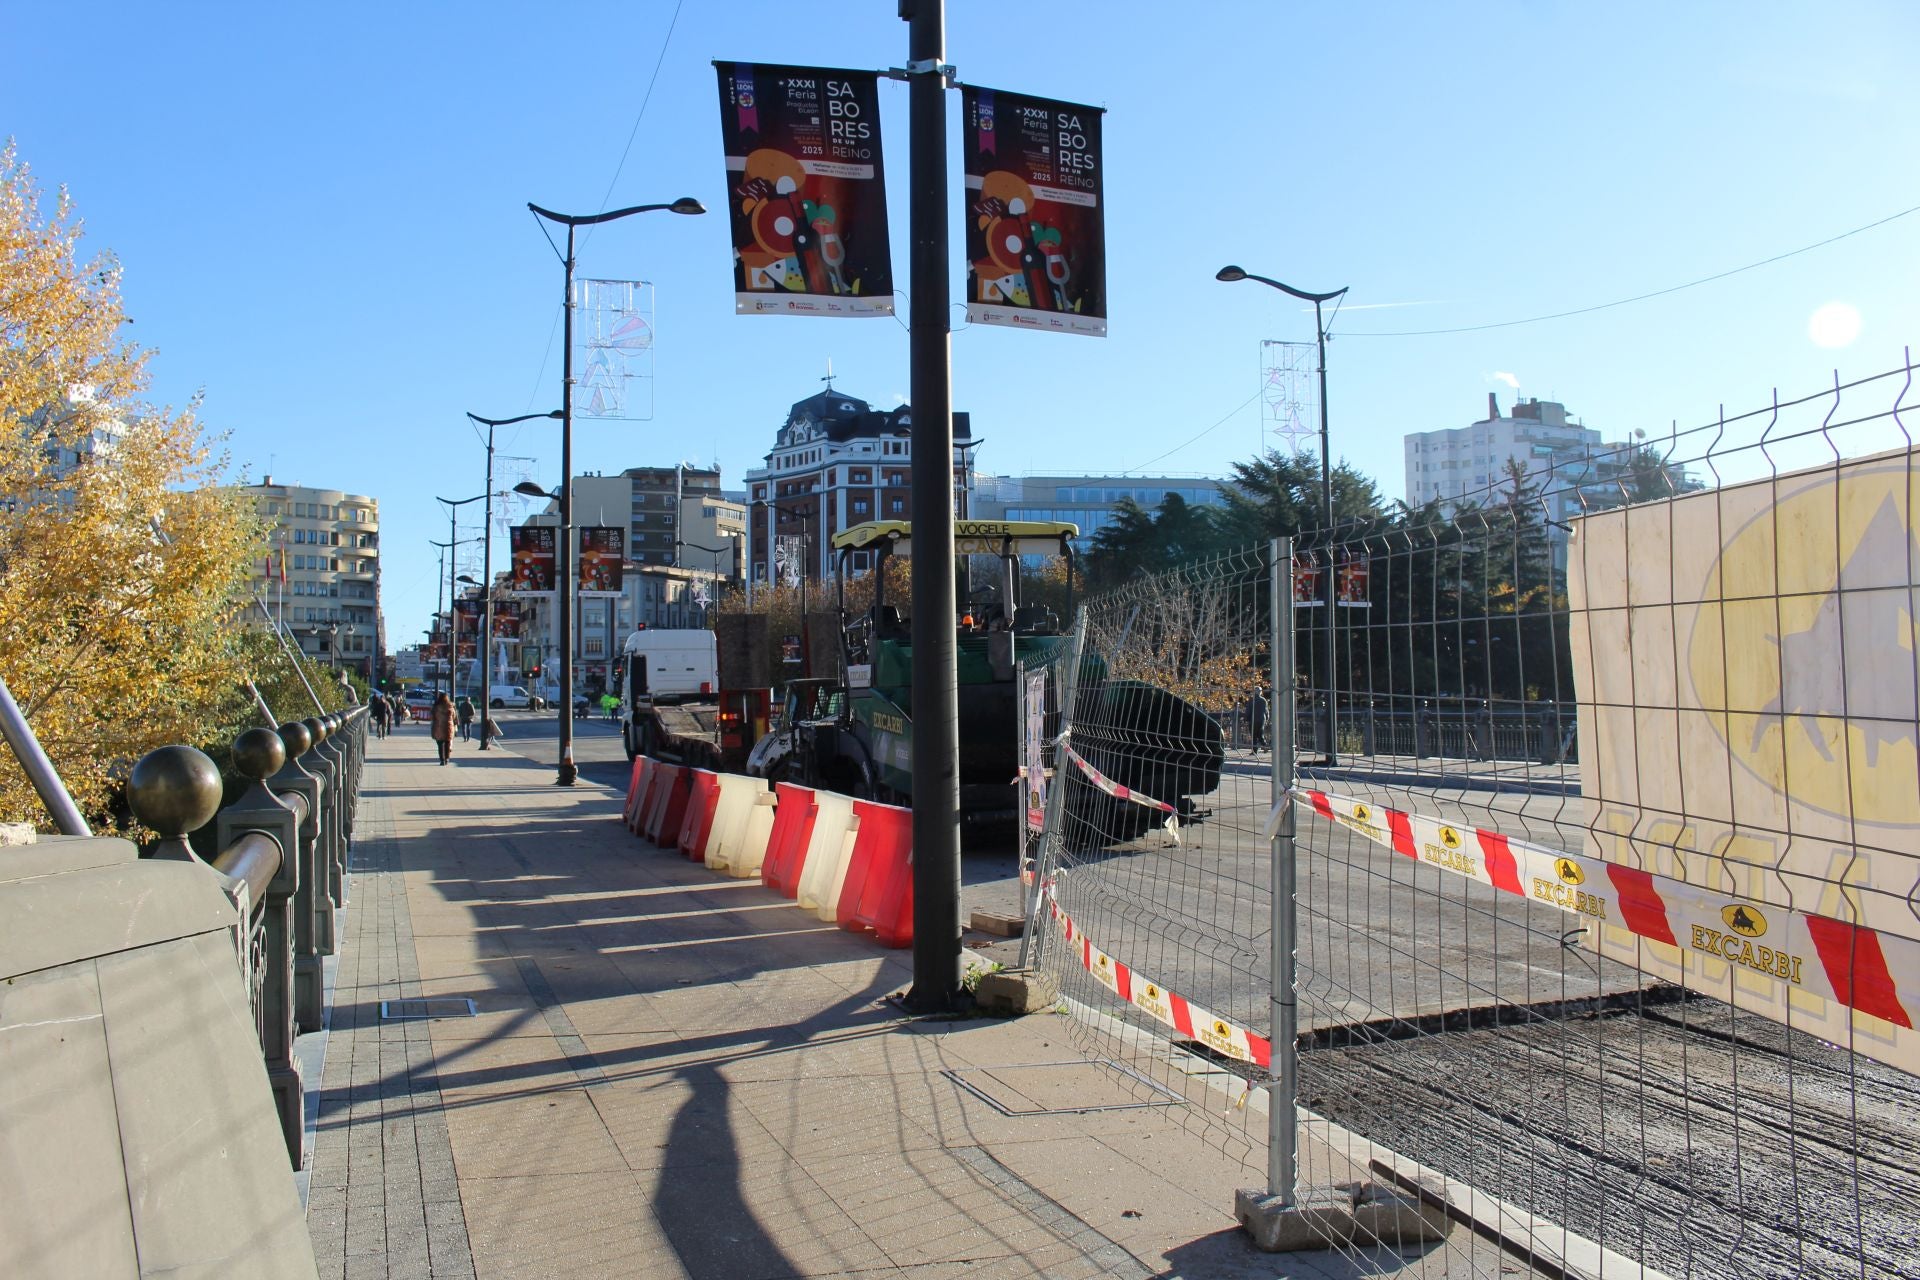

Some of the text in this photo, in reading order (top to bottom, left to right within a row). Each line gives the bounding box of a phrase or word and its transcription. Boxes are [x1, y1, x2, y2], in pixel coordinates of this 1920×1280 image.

[788, 79, 816, 89] XXXI
[826, 81, 855, 98] SA
[788, 89, 817, 100] Feria
[829, 100, 860, 118] BO
[1023, 107, 1048, 120] XXXI
[831, 120, 871, 138] RES
[1023, 117, 1048, 130] Feria
[1057, 113, 1082, 131] SA
[1059, 131, 1087, 149] BO
[802, 145, 823, 155] 2025
[832, 146, 871, 159] REINO
[1059, 150, 1095, 169] RES
[1033, 172, 1051, 182] 2025
[1060, 174, 1095, 189] REINO
[1424, 843, 1477, 876] EXCARBI
[1533, 878, 1607, 919] EXCARBI
[1691, 924, 1802, 984] EXCARBI
